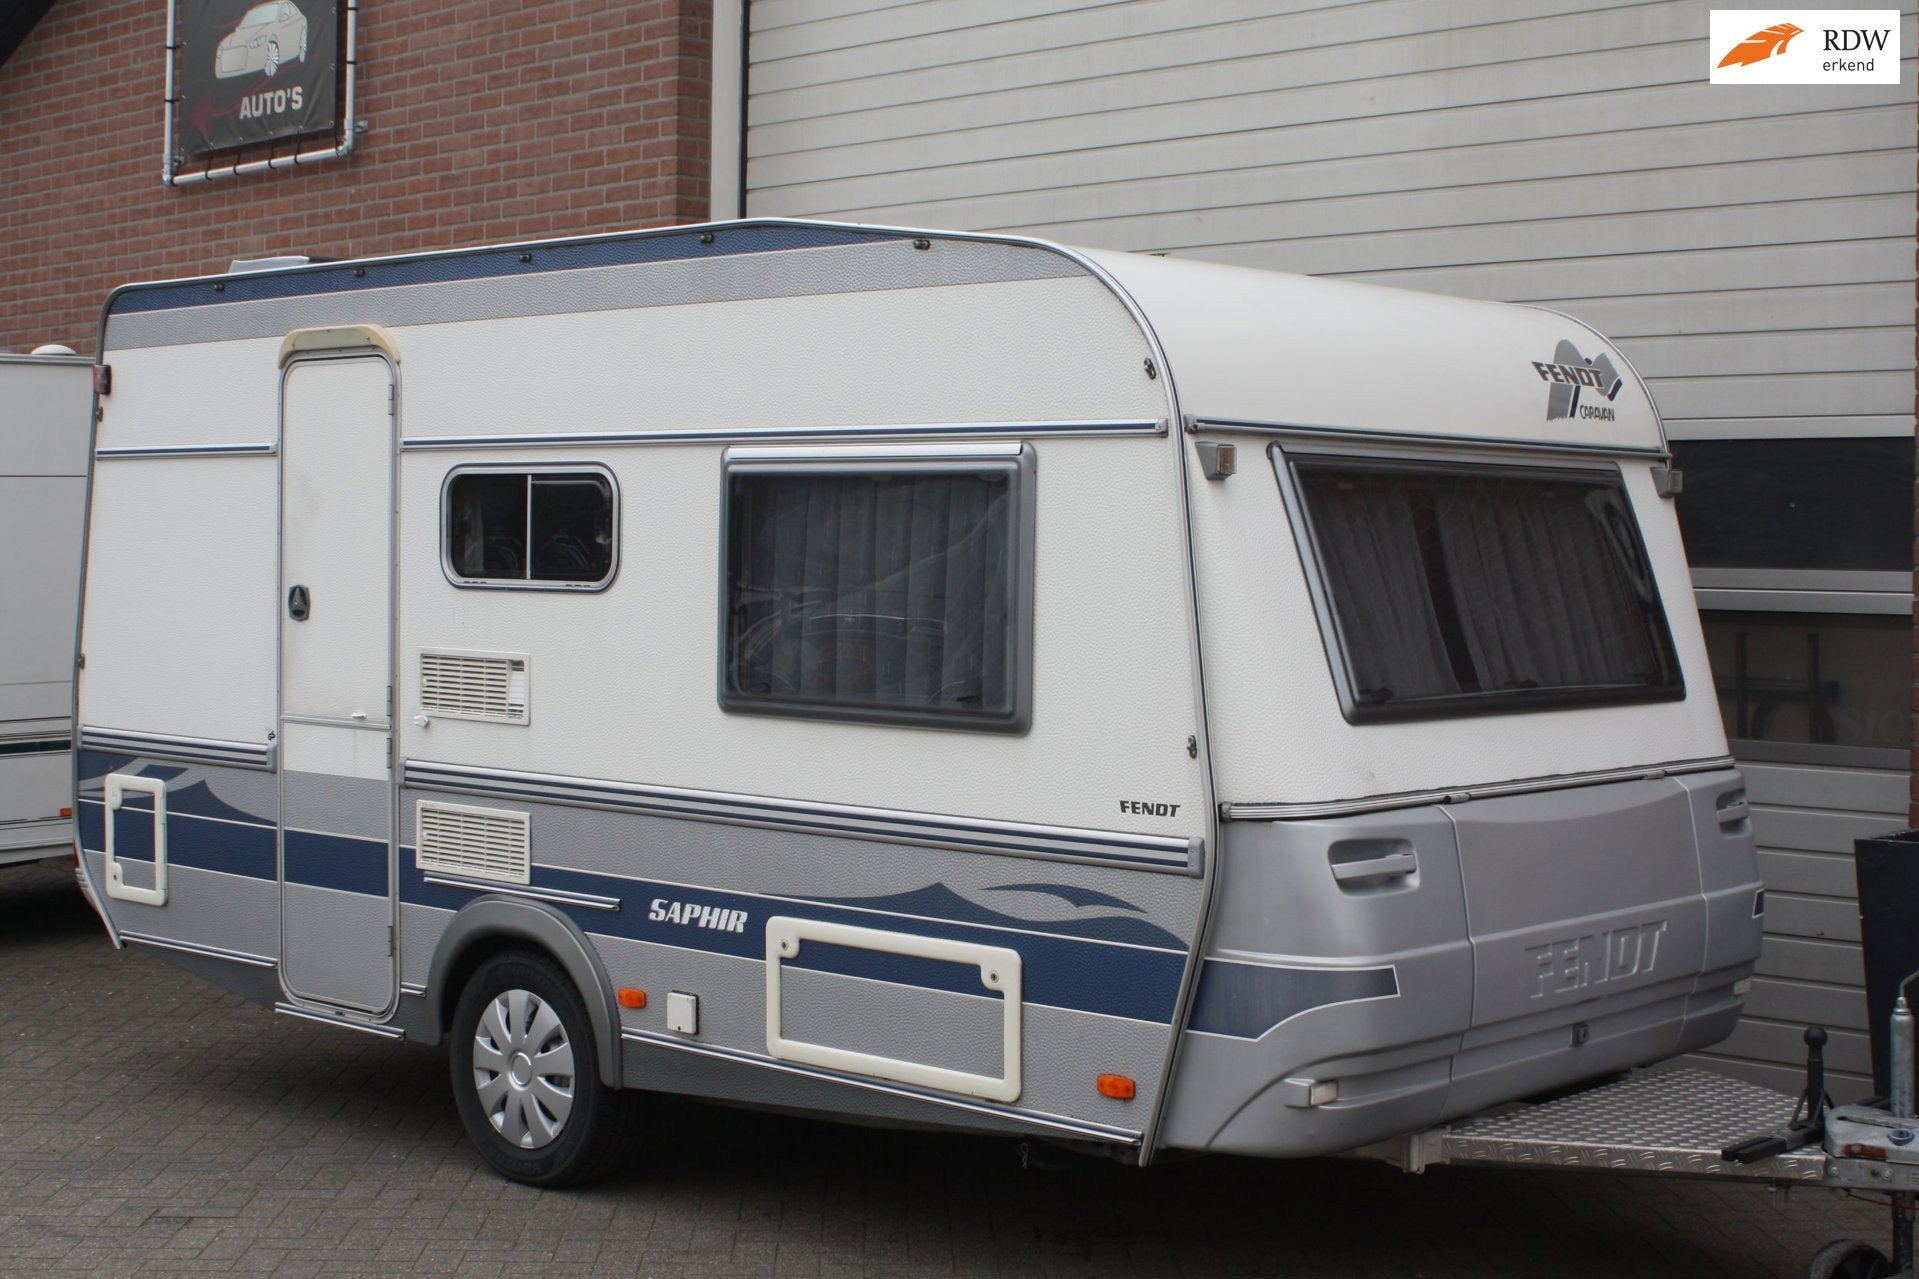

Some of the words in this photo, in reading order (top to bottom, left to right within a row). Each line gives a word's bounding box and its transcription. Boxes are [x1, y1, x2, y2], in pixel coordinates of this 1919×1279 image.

[239, 86, 303, 120] AUTO'S
[1531, 361, 1604, 388] FENDT
[1579, 405, 1615, 421] CARAVAN
[1119, 800, 1181, 817] FENDT
[648, 898, 748, 933] SAPHIR
[1525, 920, 1667, 999] FENDT
